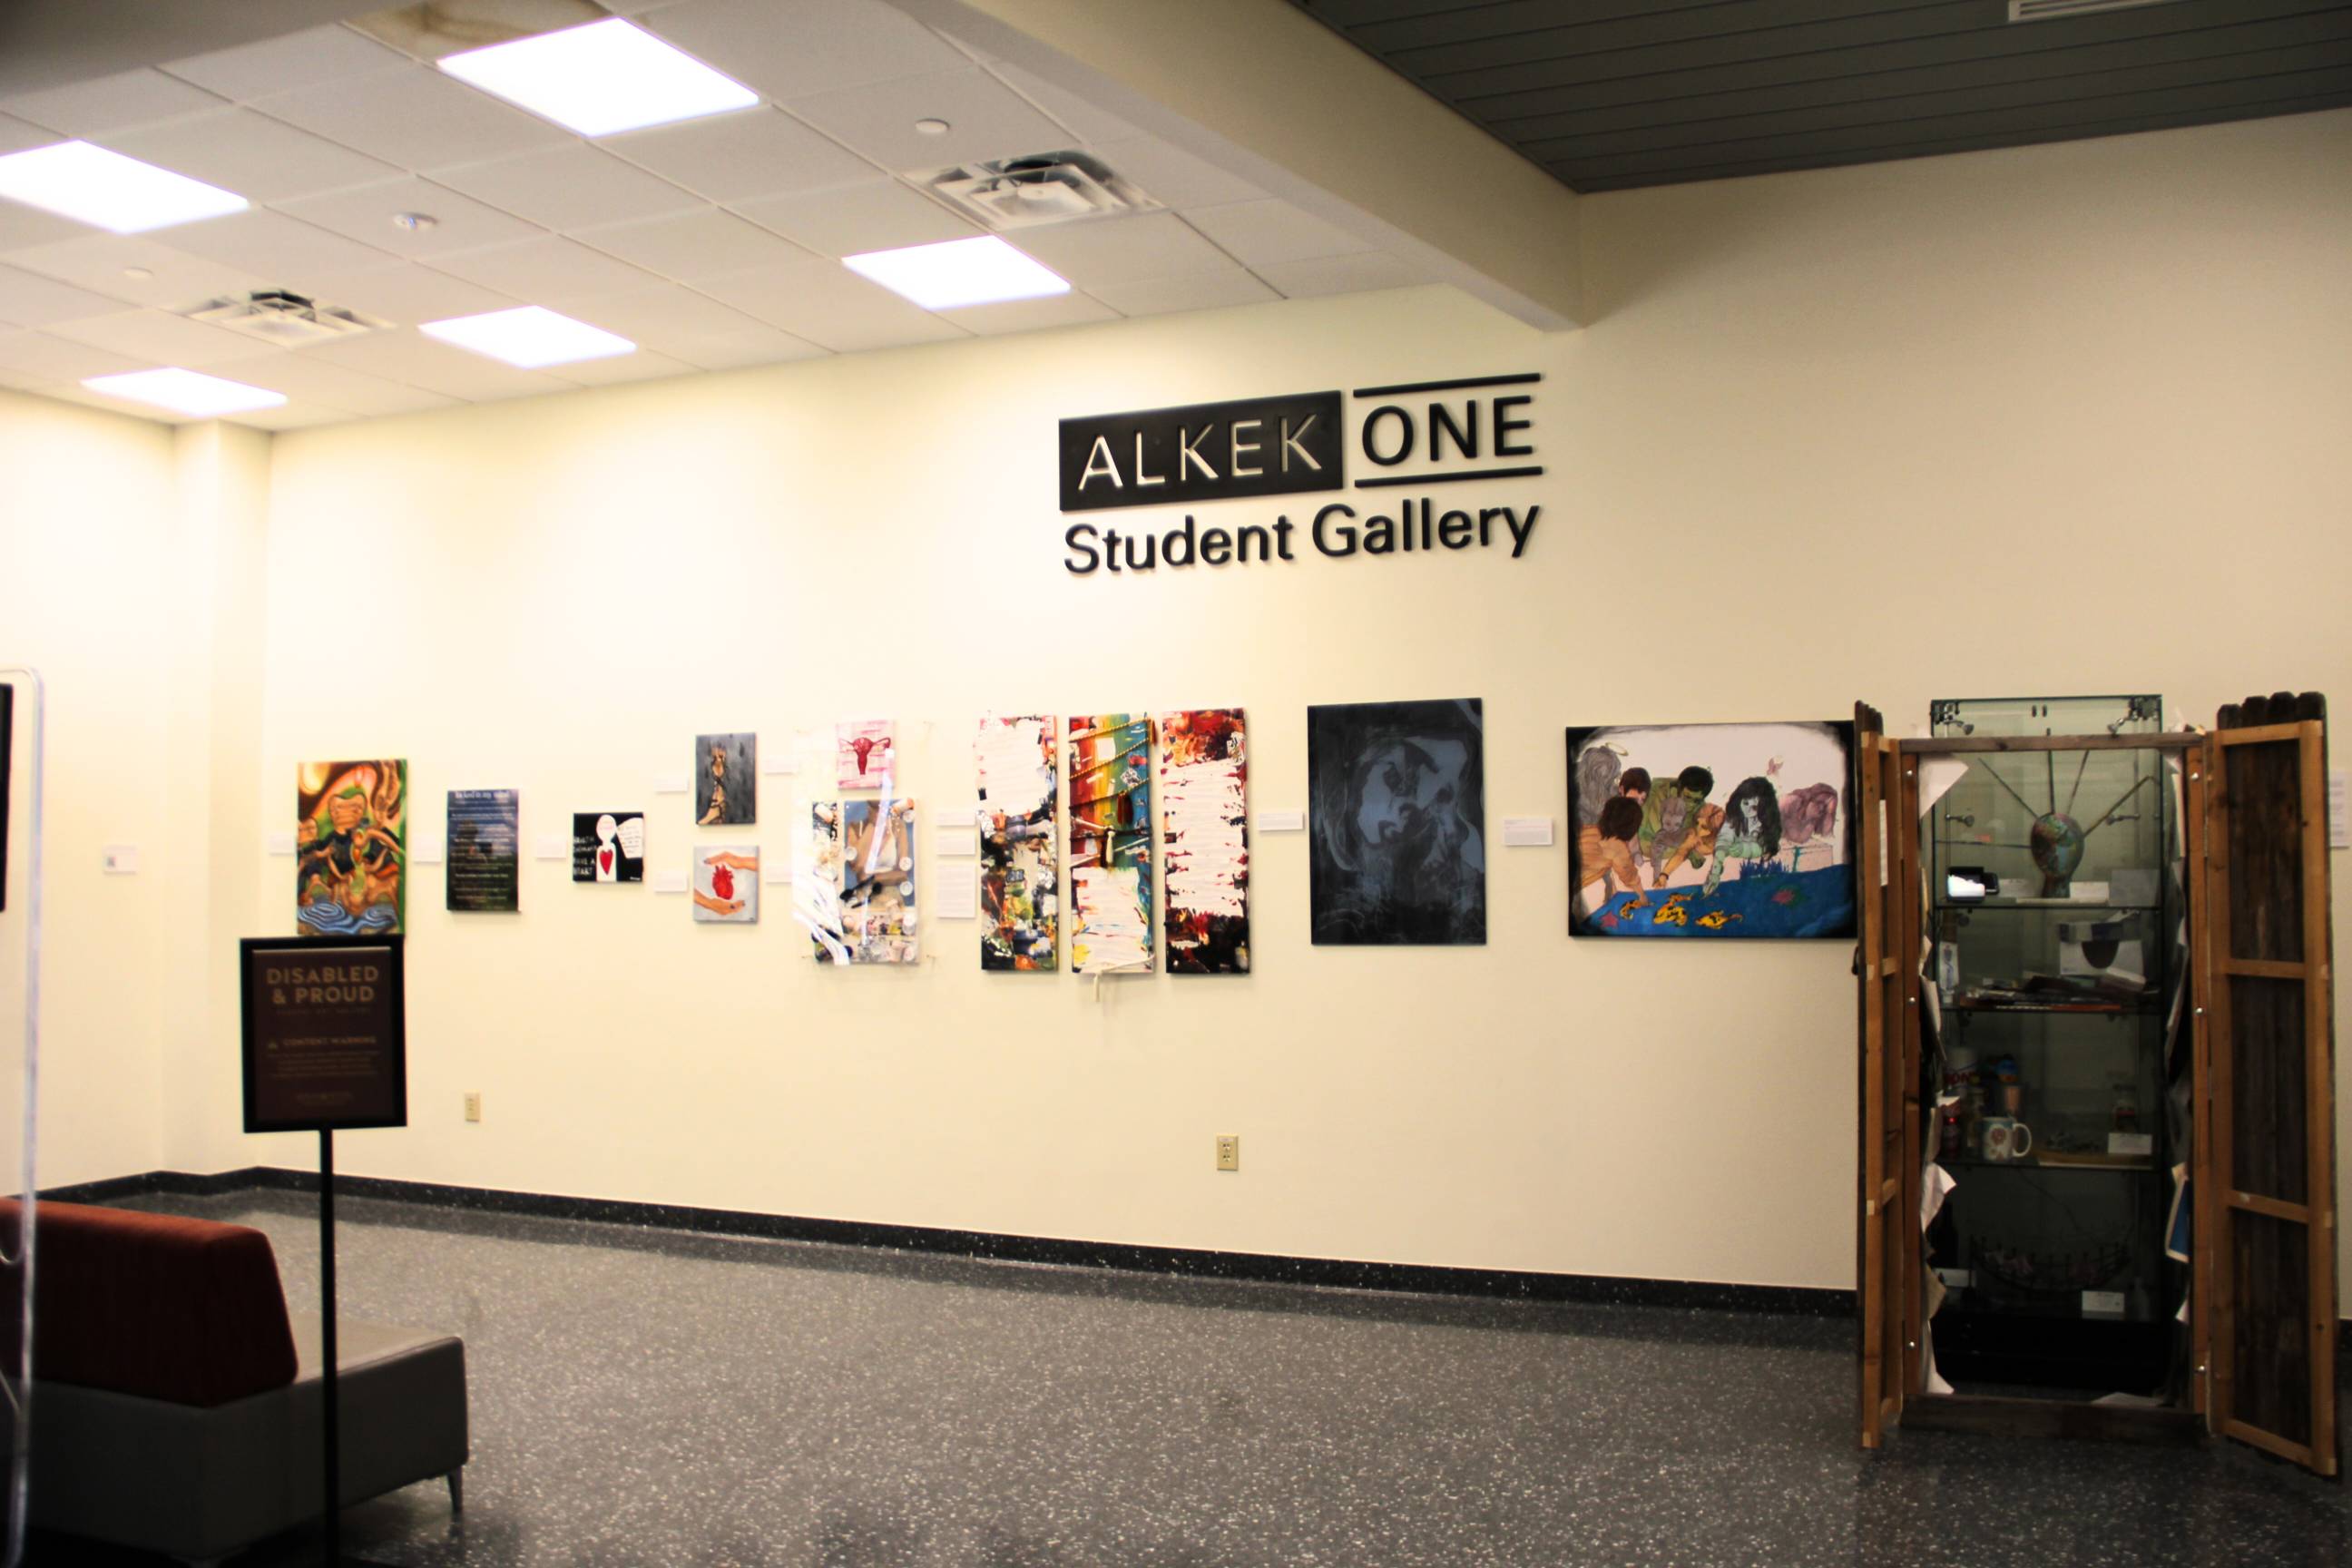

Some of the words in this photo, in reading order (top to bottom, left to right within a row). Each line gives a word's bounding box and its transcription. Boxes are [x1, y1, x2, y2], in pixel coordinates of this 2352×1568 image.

[1078, 414, 1322, 491] ALKEK
[1361, 395, 1534, 466] ONE
[1063, 514, 1294, 574] Student
[1311, 497, 1540, 558] Gallery
[267, 965, 378, 985] DISABLED
[273, 987, 287, 1004] &
[295, 985, 375, 1004] PROUD
